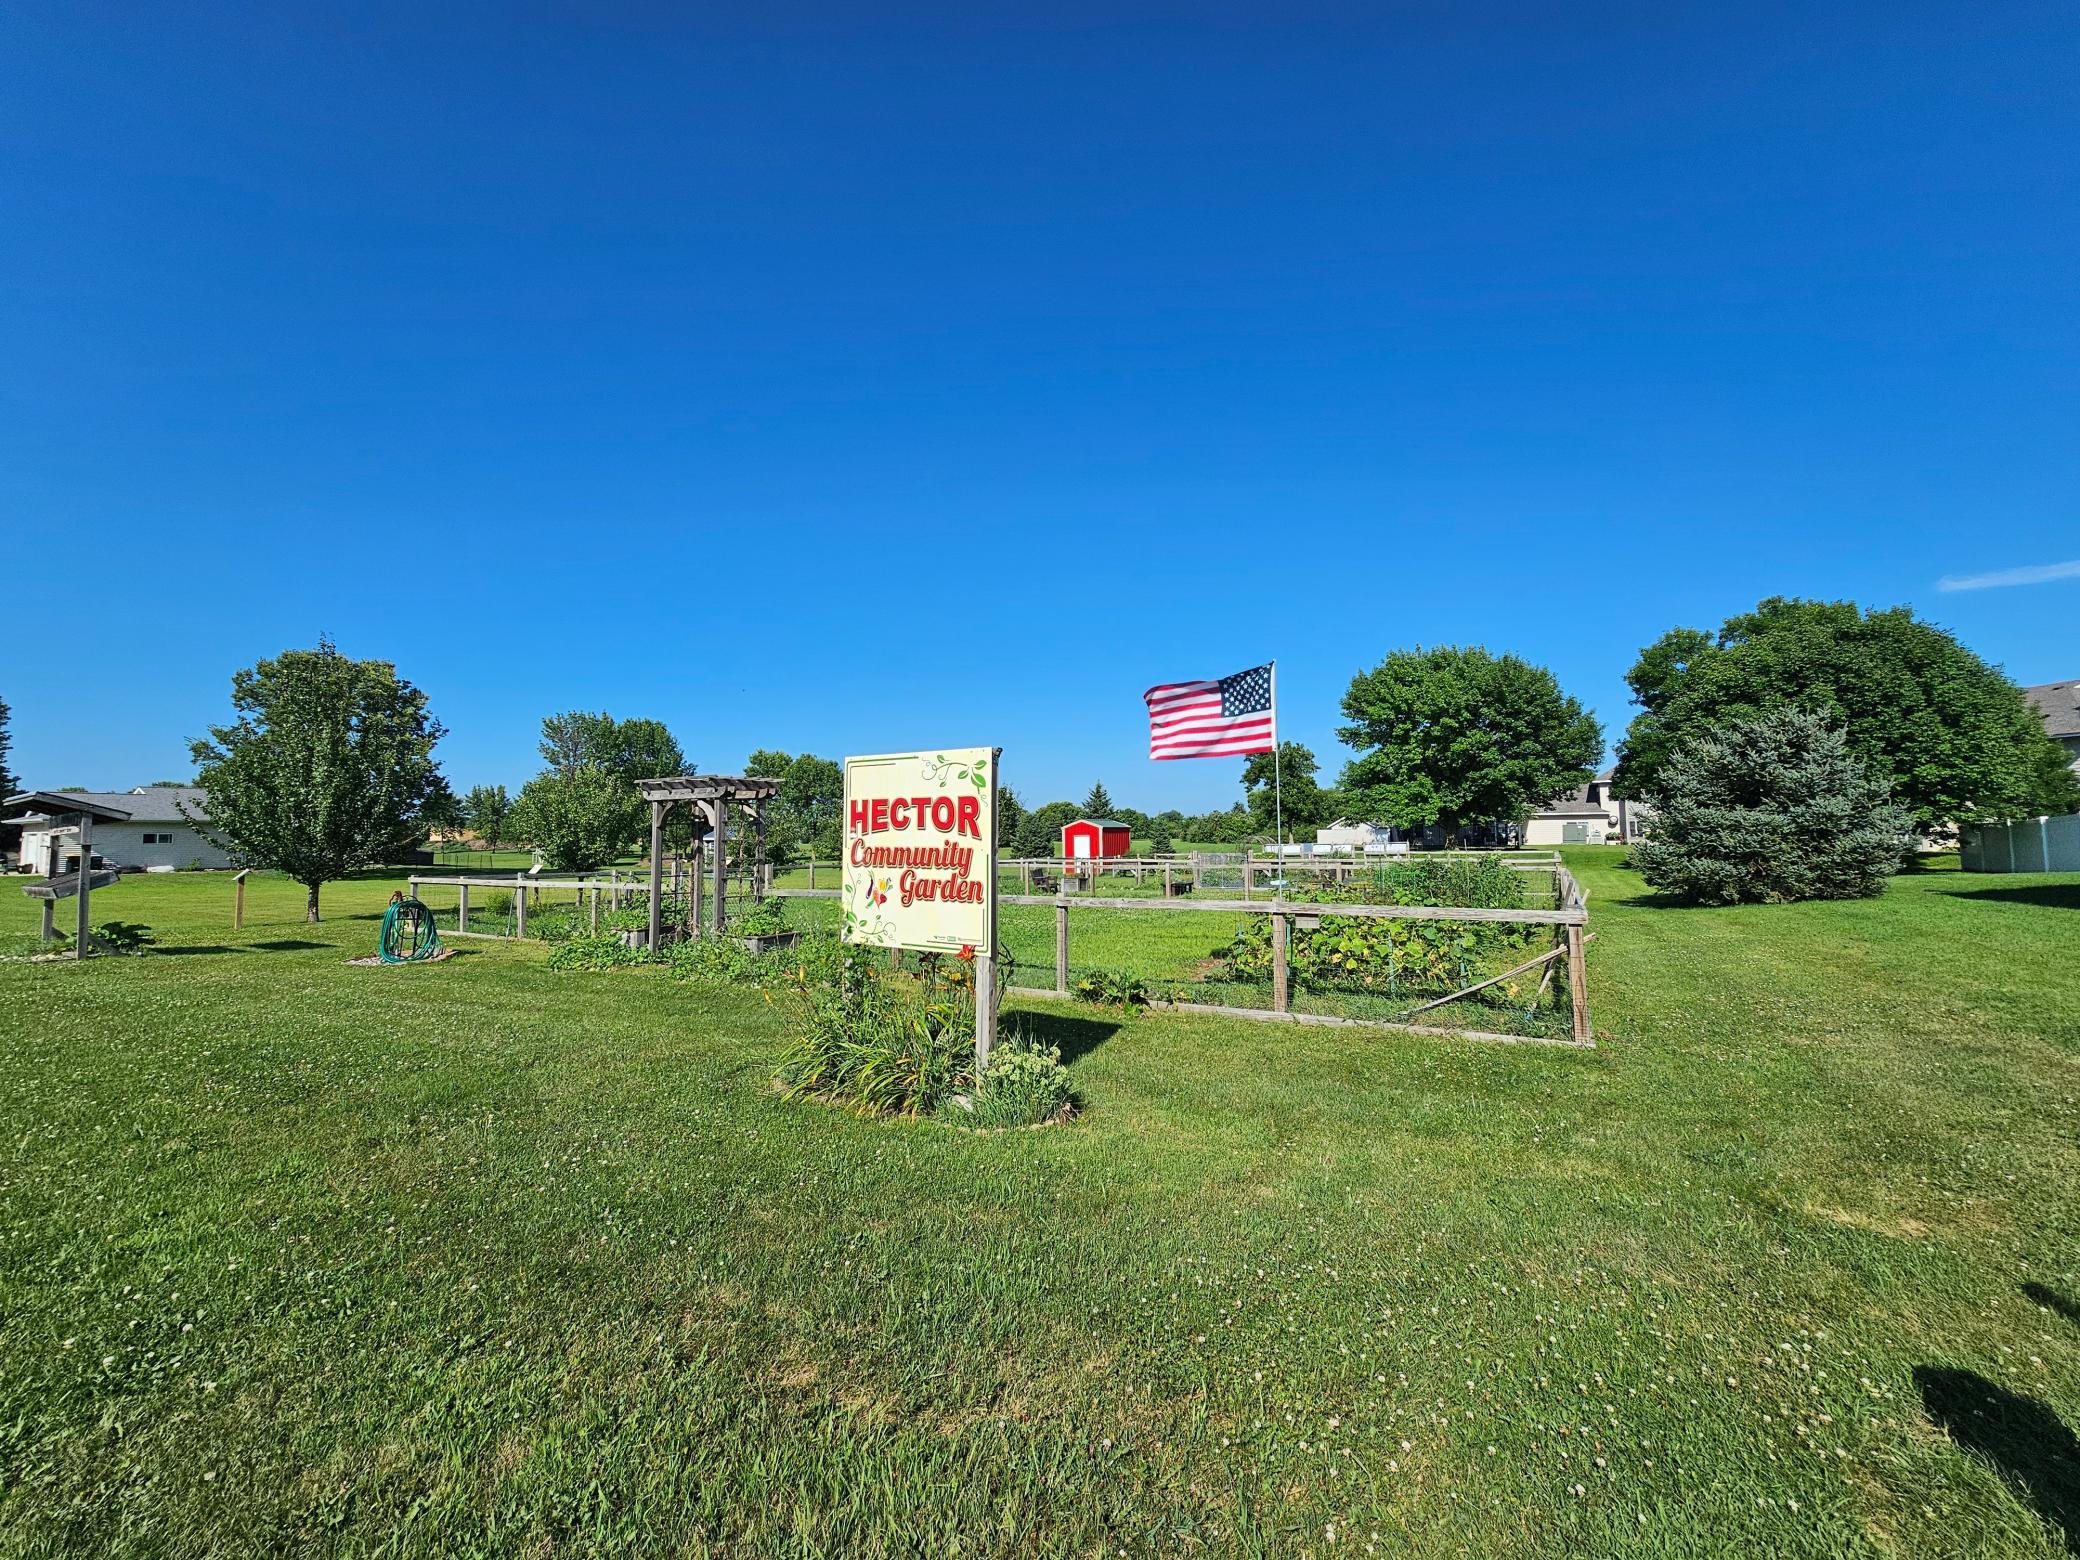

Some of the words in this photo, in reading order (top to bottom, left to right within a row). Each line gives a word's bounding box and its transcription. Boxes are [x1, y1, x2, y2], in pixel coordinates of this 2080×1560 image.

[850, 796, 982, 840] HECTOR
[851, 838, 974, 877] Community
[899, 869, 985, 907] Garden
